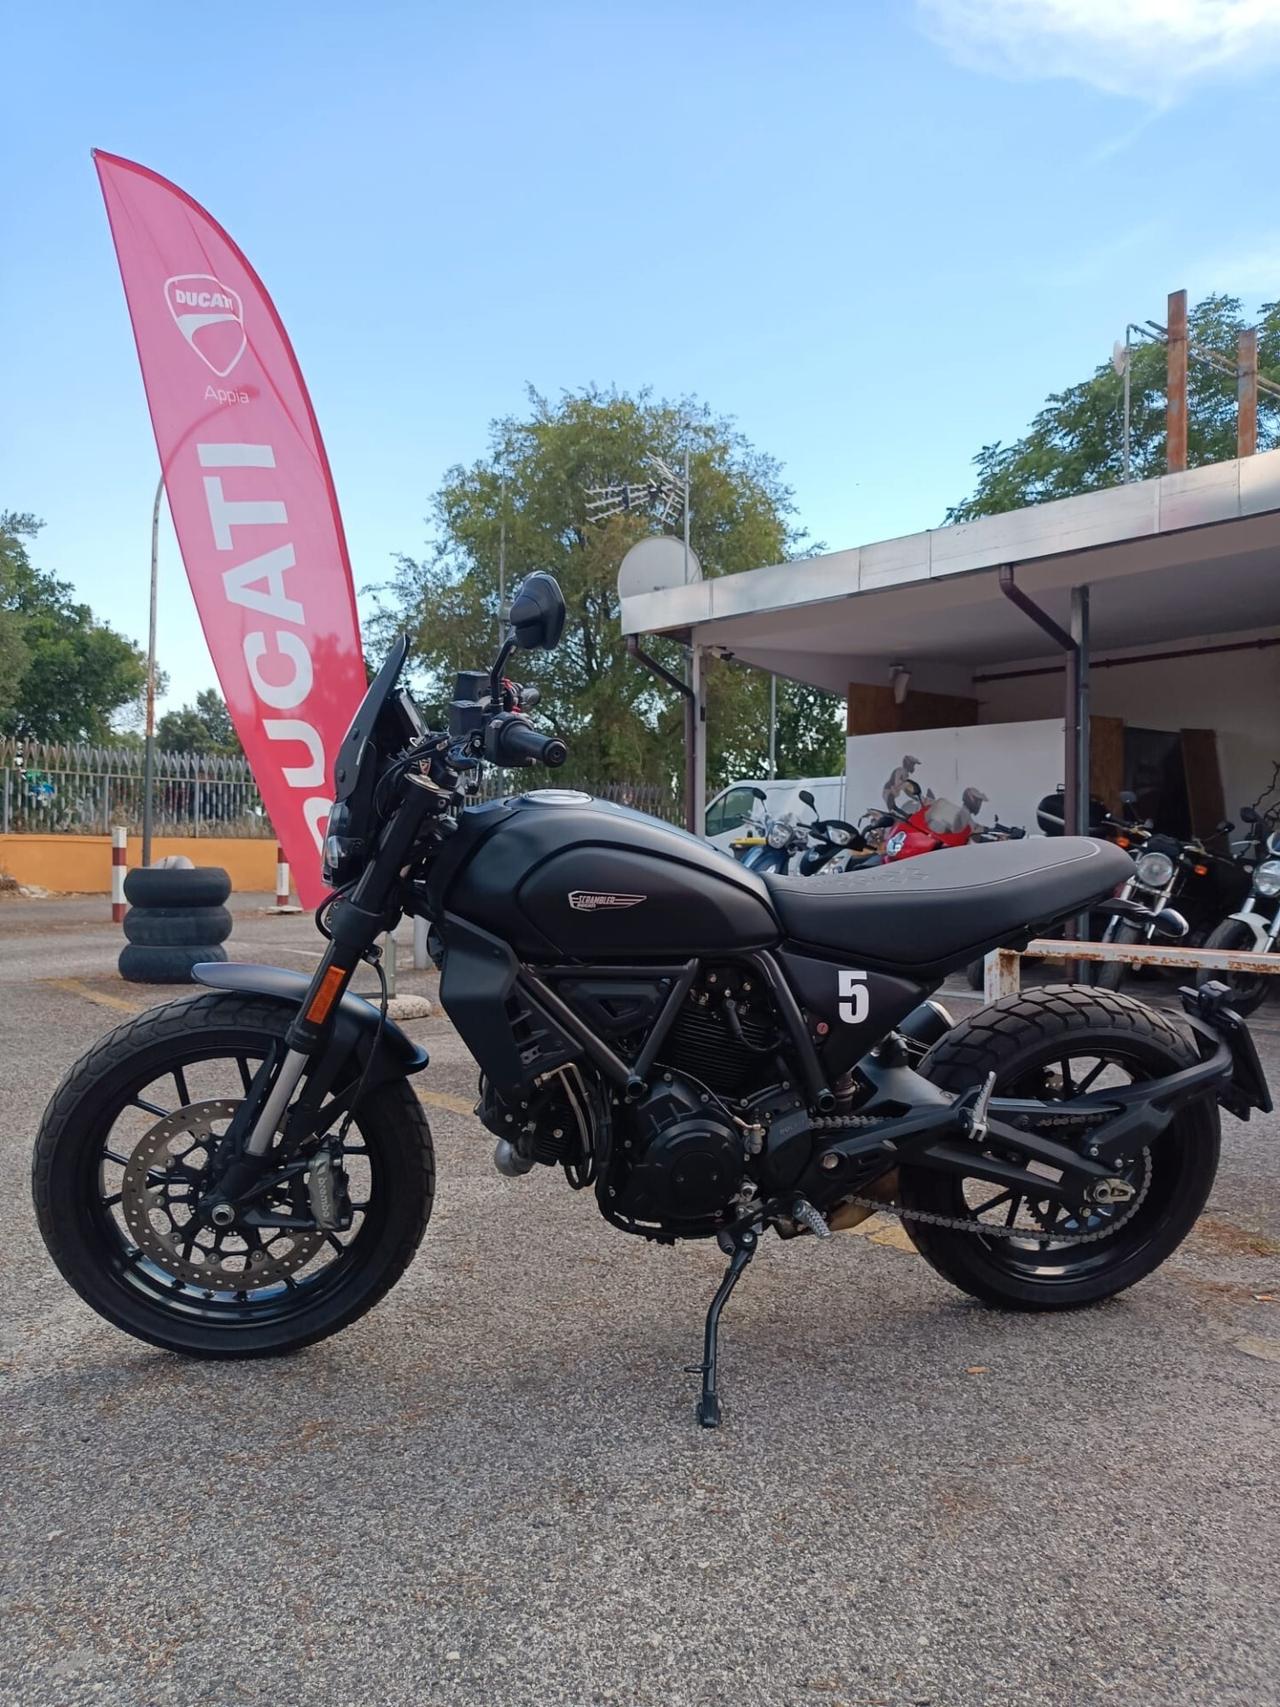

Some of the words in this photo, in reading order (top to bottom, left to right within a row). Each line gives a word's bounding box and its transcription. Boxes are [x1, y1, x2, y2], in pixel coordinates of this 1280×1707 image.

[204, 385, 249, 406] Appia
[196, 443, 334, 857] DUCATI
[578, 895, 616, 905] SCRAMBLER
[838, 970, 870, 1024] 5
[318, 1176, 330, 1218] brembo
